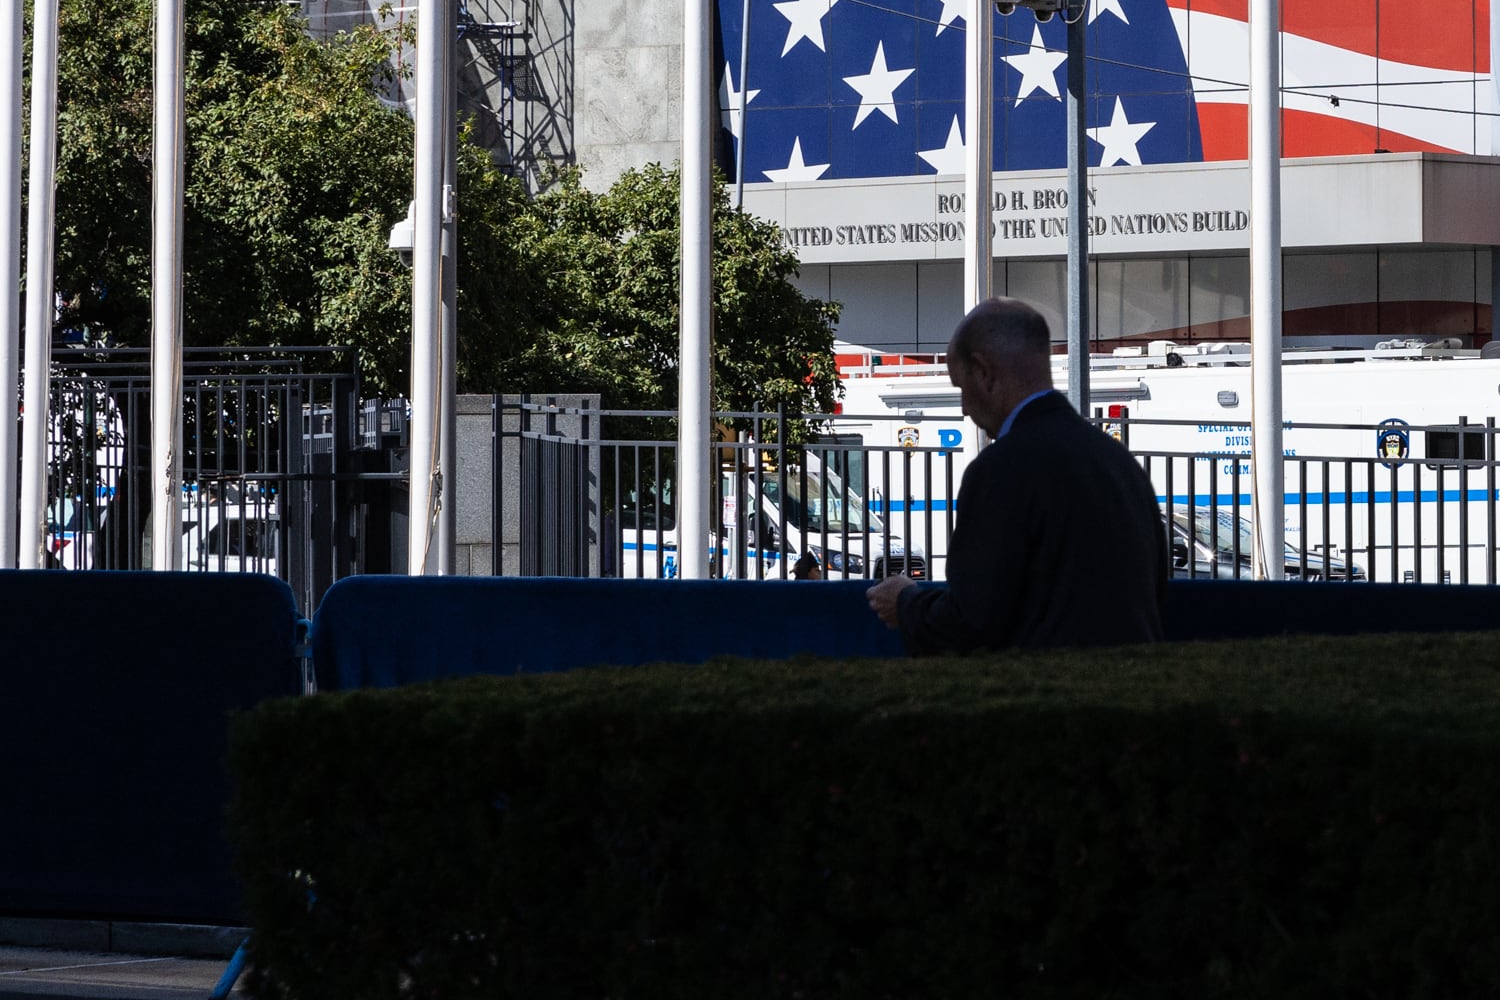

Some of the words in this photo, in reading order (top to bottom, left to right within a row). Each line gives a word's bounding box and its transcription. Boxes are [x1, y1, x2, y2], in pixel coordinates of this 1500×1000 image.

[937, 192, 1006, 213] ROD
[1011, 190, 1028, 211] H.
[1033, 187, 1097, 210] BRON
[780, 226, 832, 248] NITED
[836, 224, 896, 245] STATES
[1000, 218, 1036, 239] THE
[1040, 215, 1107, 238] UNIED
[1111, 211, 1188, 235] NATIONS
[1192, 209, 1250, 232] BUILD
